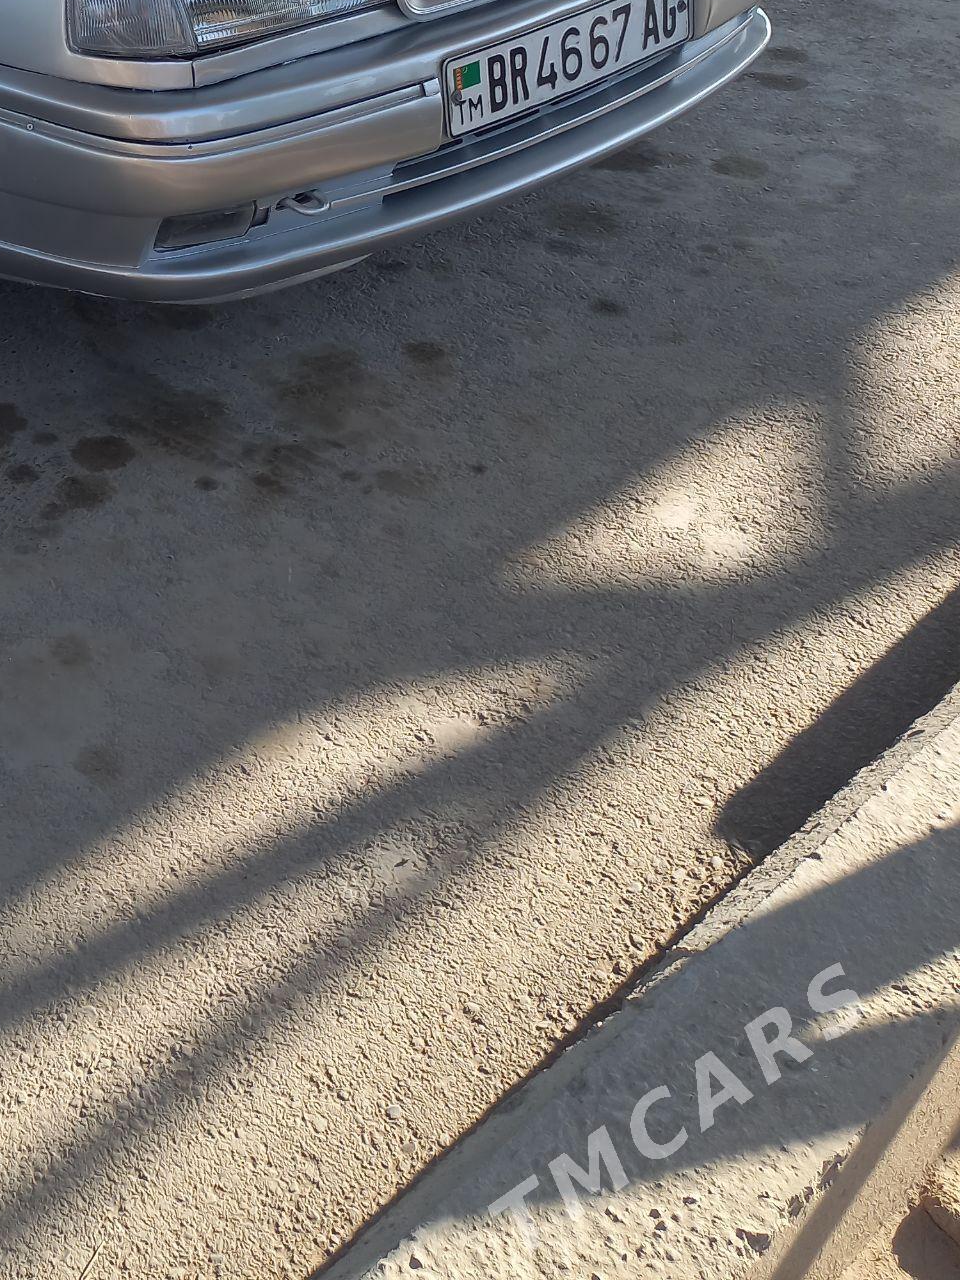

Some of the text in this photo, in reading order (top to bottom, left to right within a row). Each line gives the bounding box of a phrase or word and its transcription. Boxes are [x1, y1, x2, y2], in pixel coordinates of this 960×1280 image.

[487, 46, 530, 113] BR
[536, 3, 631, 90] 4667
[453, 94, 484, 125] TM
